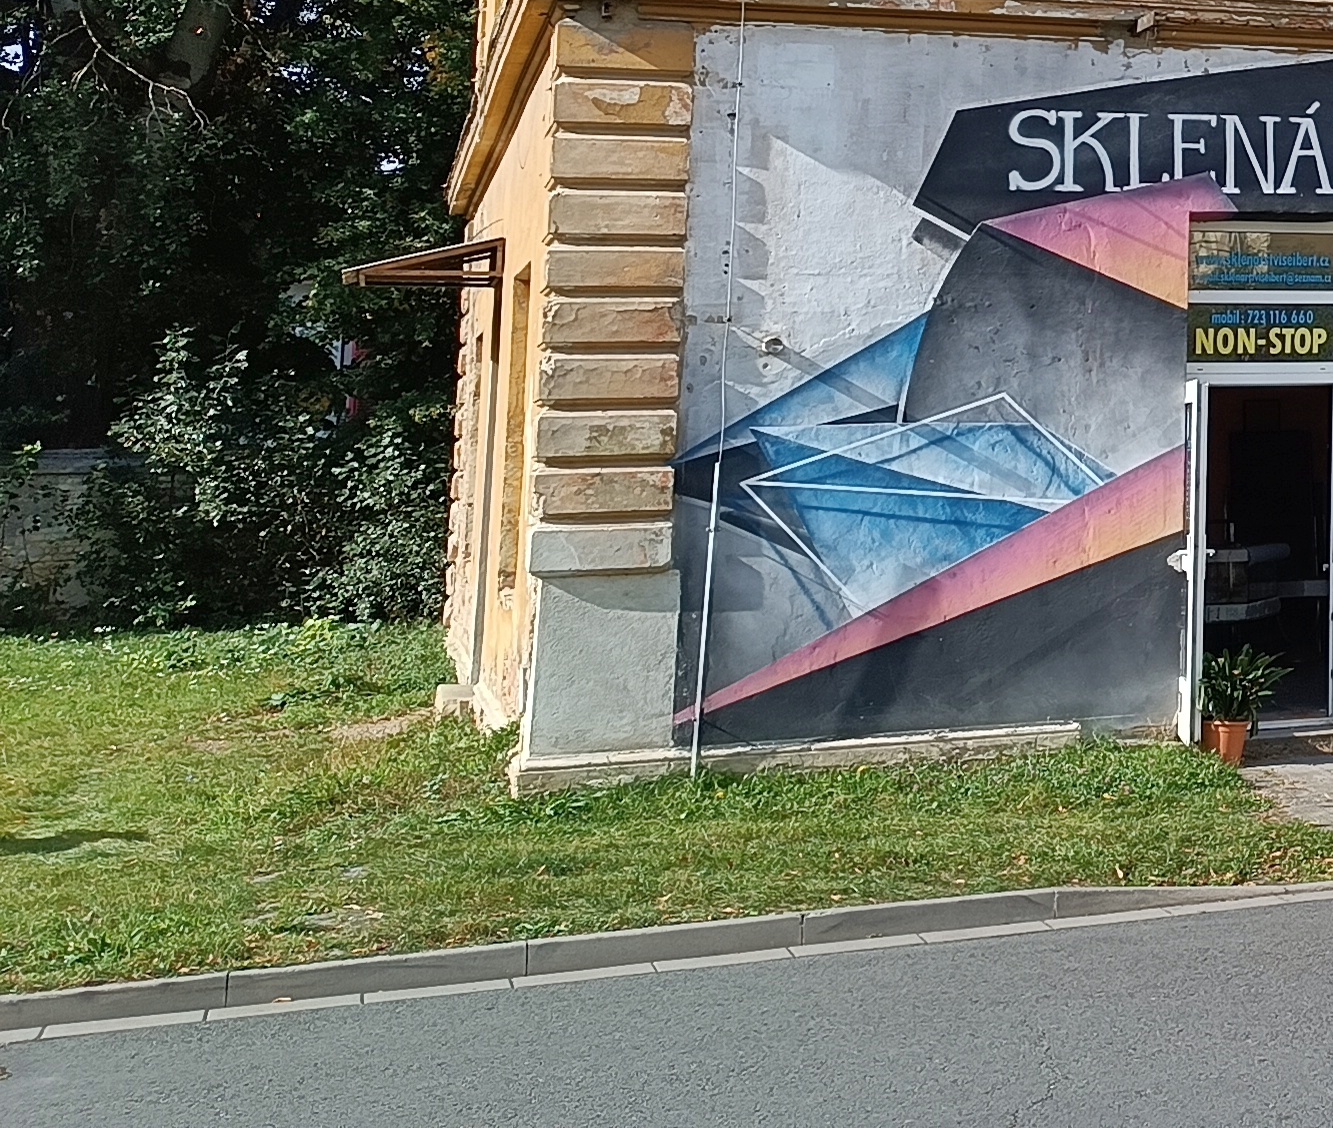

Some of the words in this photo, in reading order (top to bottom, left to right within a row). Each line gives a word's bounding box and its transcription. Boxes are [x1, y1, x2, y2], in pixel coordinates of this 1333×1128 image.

[1247, 310, 1267, 324] 723
[1269, 310, 1287, 324] 116
[1290, 310, 1314, 324] 660
[1195, 327, 1328, 355] NON-STOP
